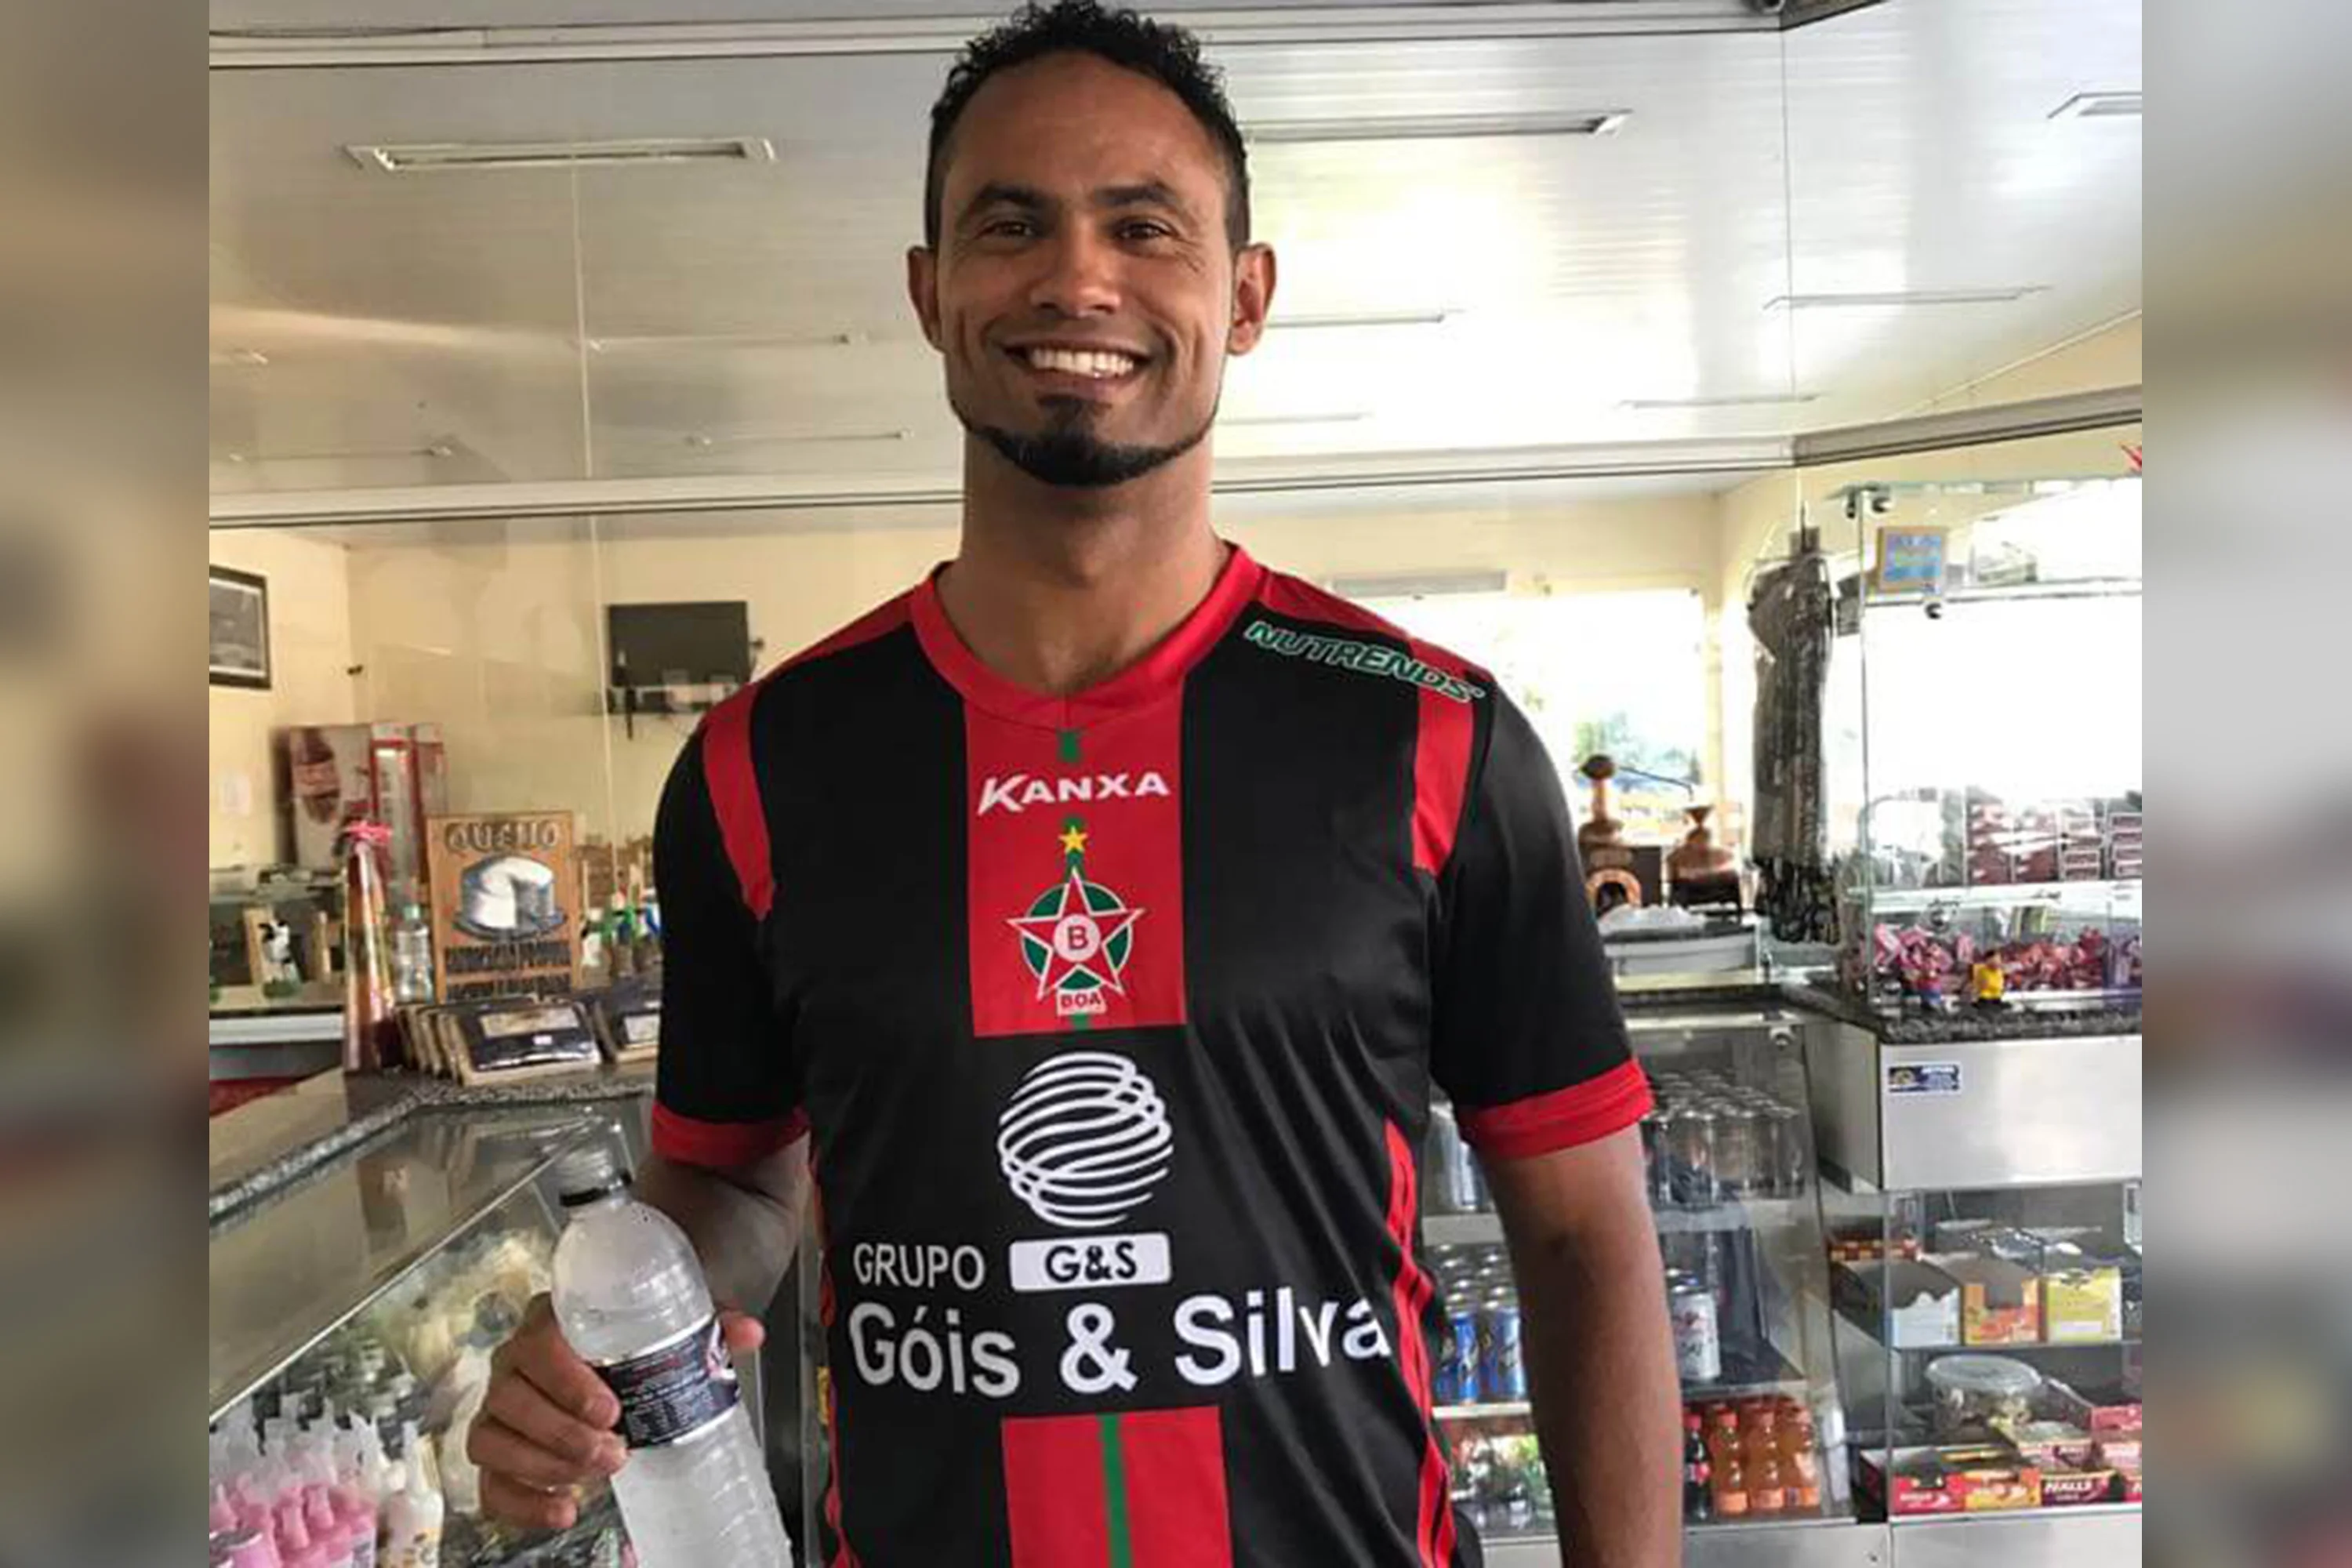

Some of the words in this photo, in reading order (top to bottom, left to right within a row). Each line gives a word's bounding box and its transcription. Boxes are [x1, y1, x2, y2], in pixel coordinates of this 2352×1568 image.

[977, 772, 1171, 815] KANXA
[1067, 925, 1090, 950] B
[1060, 991, 1102, 1009] BOA
[853, 1242, 985, 1290] GRUPO
[1044, 1243, 1138, 1284] G&S
[848, 1301, 1020, 1398] Góis
[1058, 1302, 1138, 1394] &
[1174, 1287, 1392, 1385] Silva
